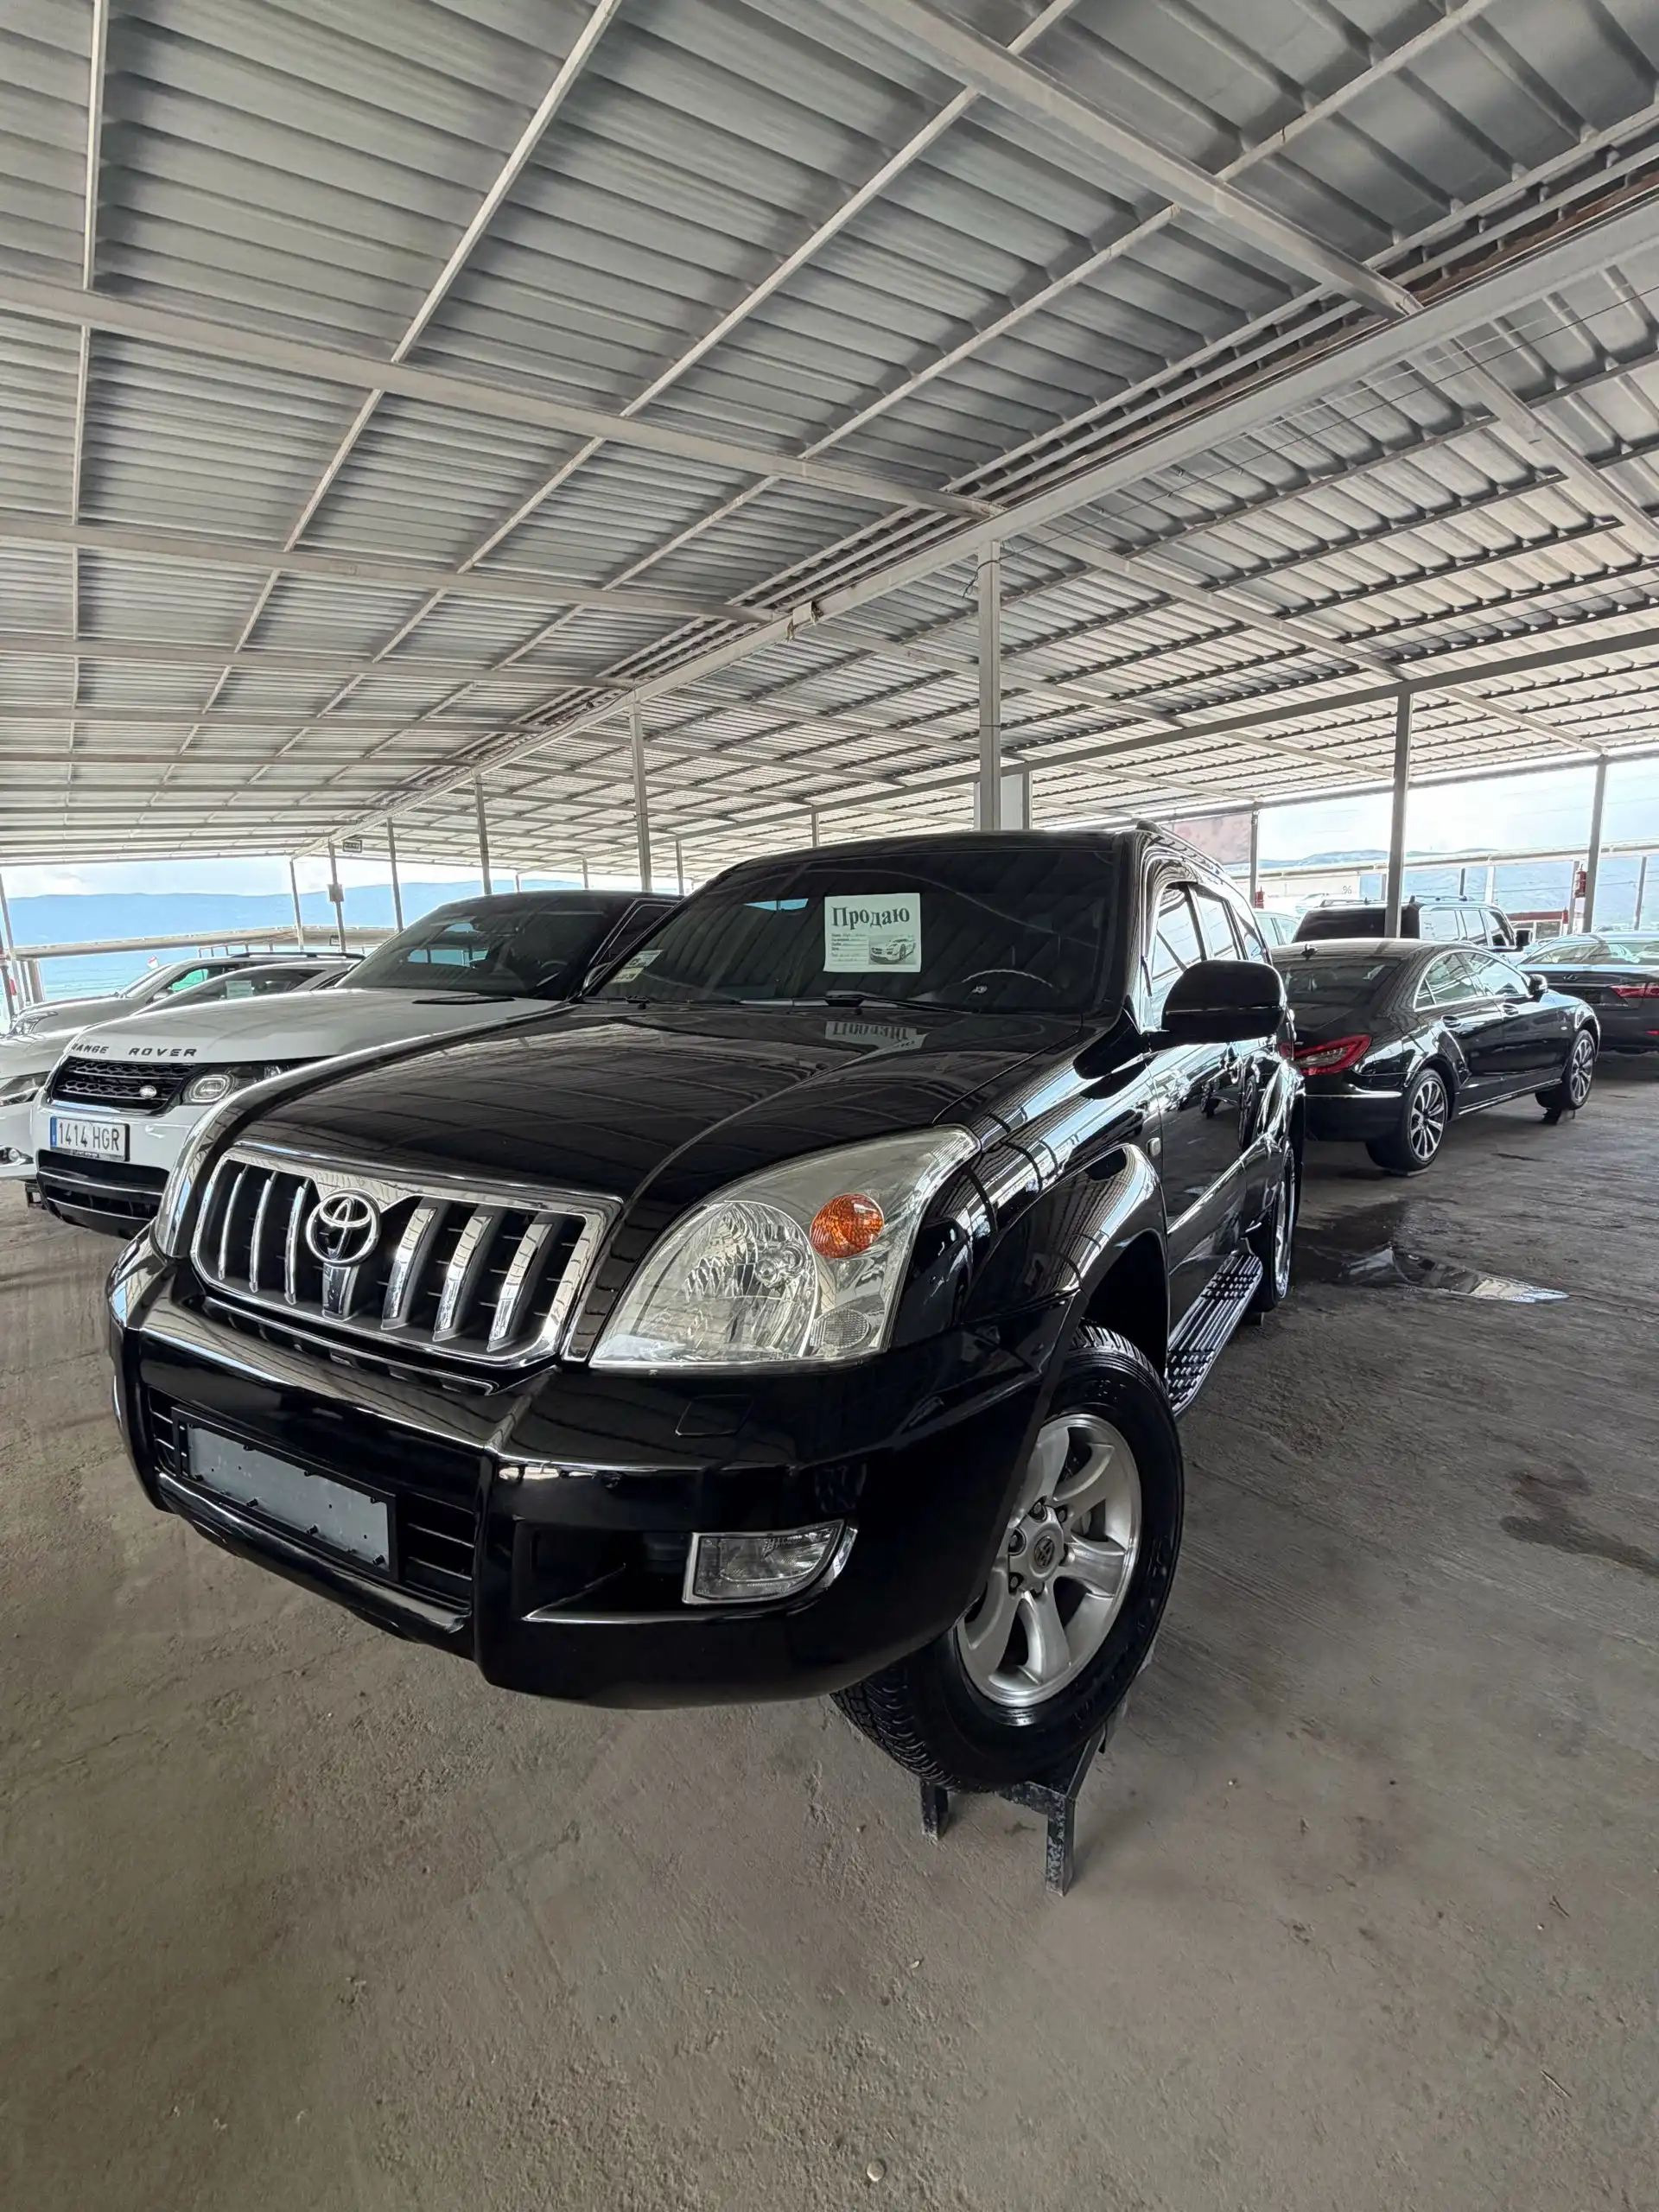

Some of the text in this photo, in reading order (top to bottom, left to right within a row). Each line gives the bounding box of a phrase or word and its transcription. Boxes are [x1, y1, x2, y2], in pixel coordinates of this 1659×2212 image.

[830, 906, 910, 930] Продаю
[128, 1047, 198, 1057] ROVER
[59, 1122, 119, 1152] 1414 HGR
